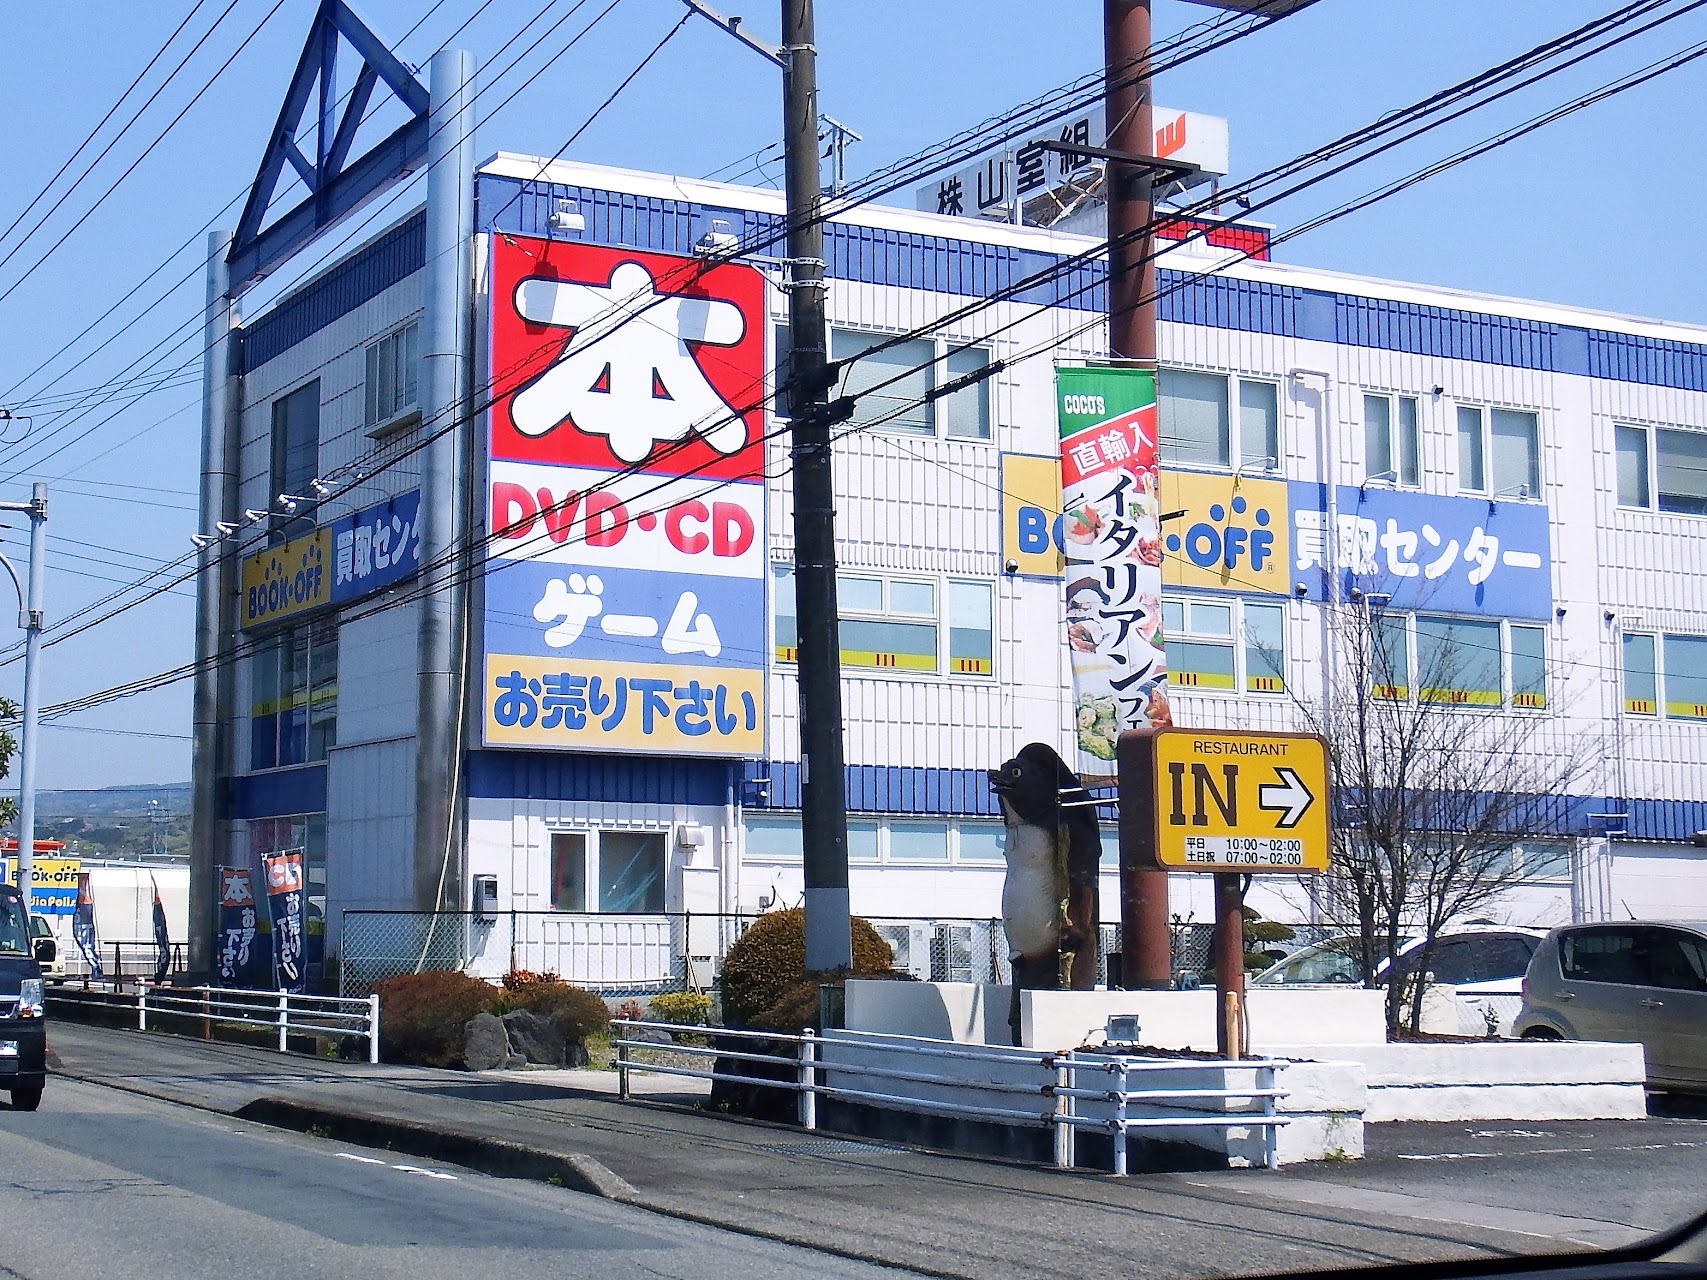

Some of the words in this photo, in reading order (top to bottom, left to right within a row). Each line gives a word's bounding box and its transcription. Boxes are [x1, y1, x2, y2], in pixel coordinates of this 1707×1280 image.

[508, 259, 748, 466] 本
[1064, 394, 1106, 416] COCO'S
[1069, 421, 1154, 476] 直輸入
[1294, 508, 1542, 586] 買取センター
[532, 573, 722, 658] ゲーム
[493, 670, 756, 736] お売り下さい
[1193, 740, 1289, 756] RESTAURANT
[1168, 762, 1239, 827] IN
[1186, 837, 1205, 849] 平日
[1186, 851, 1215, 863] 土日祝
[224, 874, 252, 903] 本
